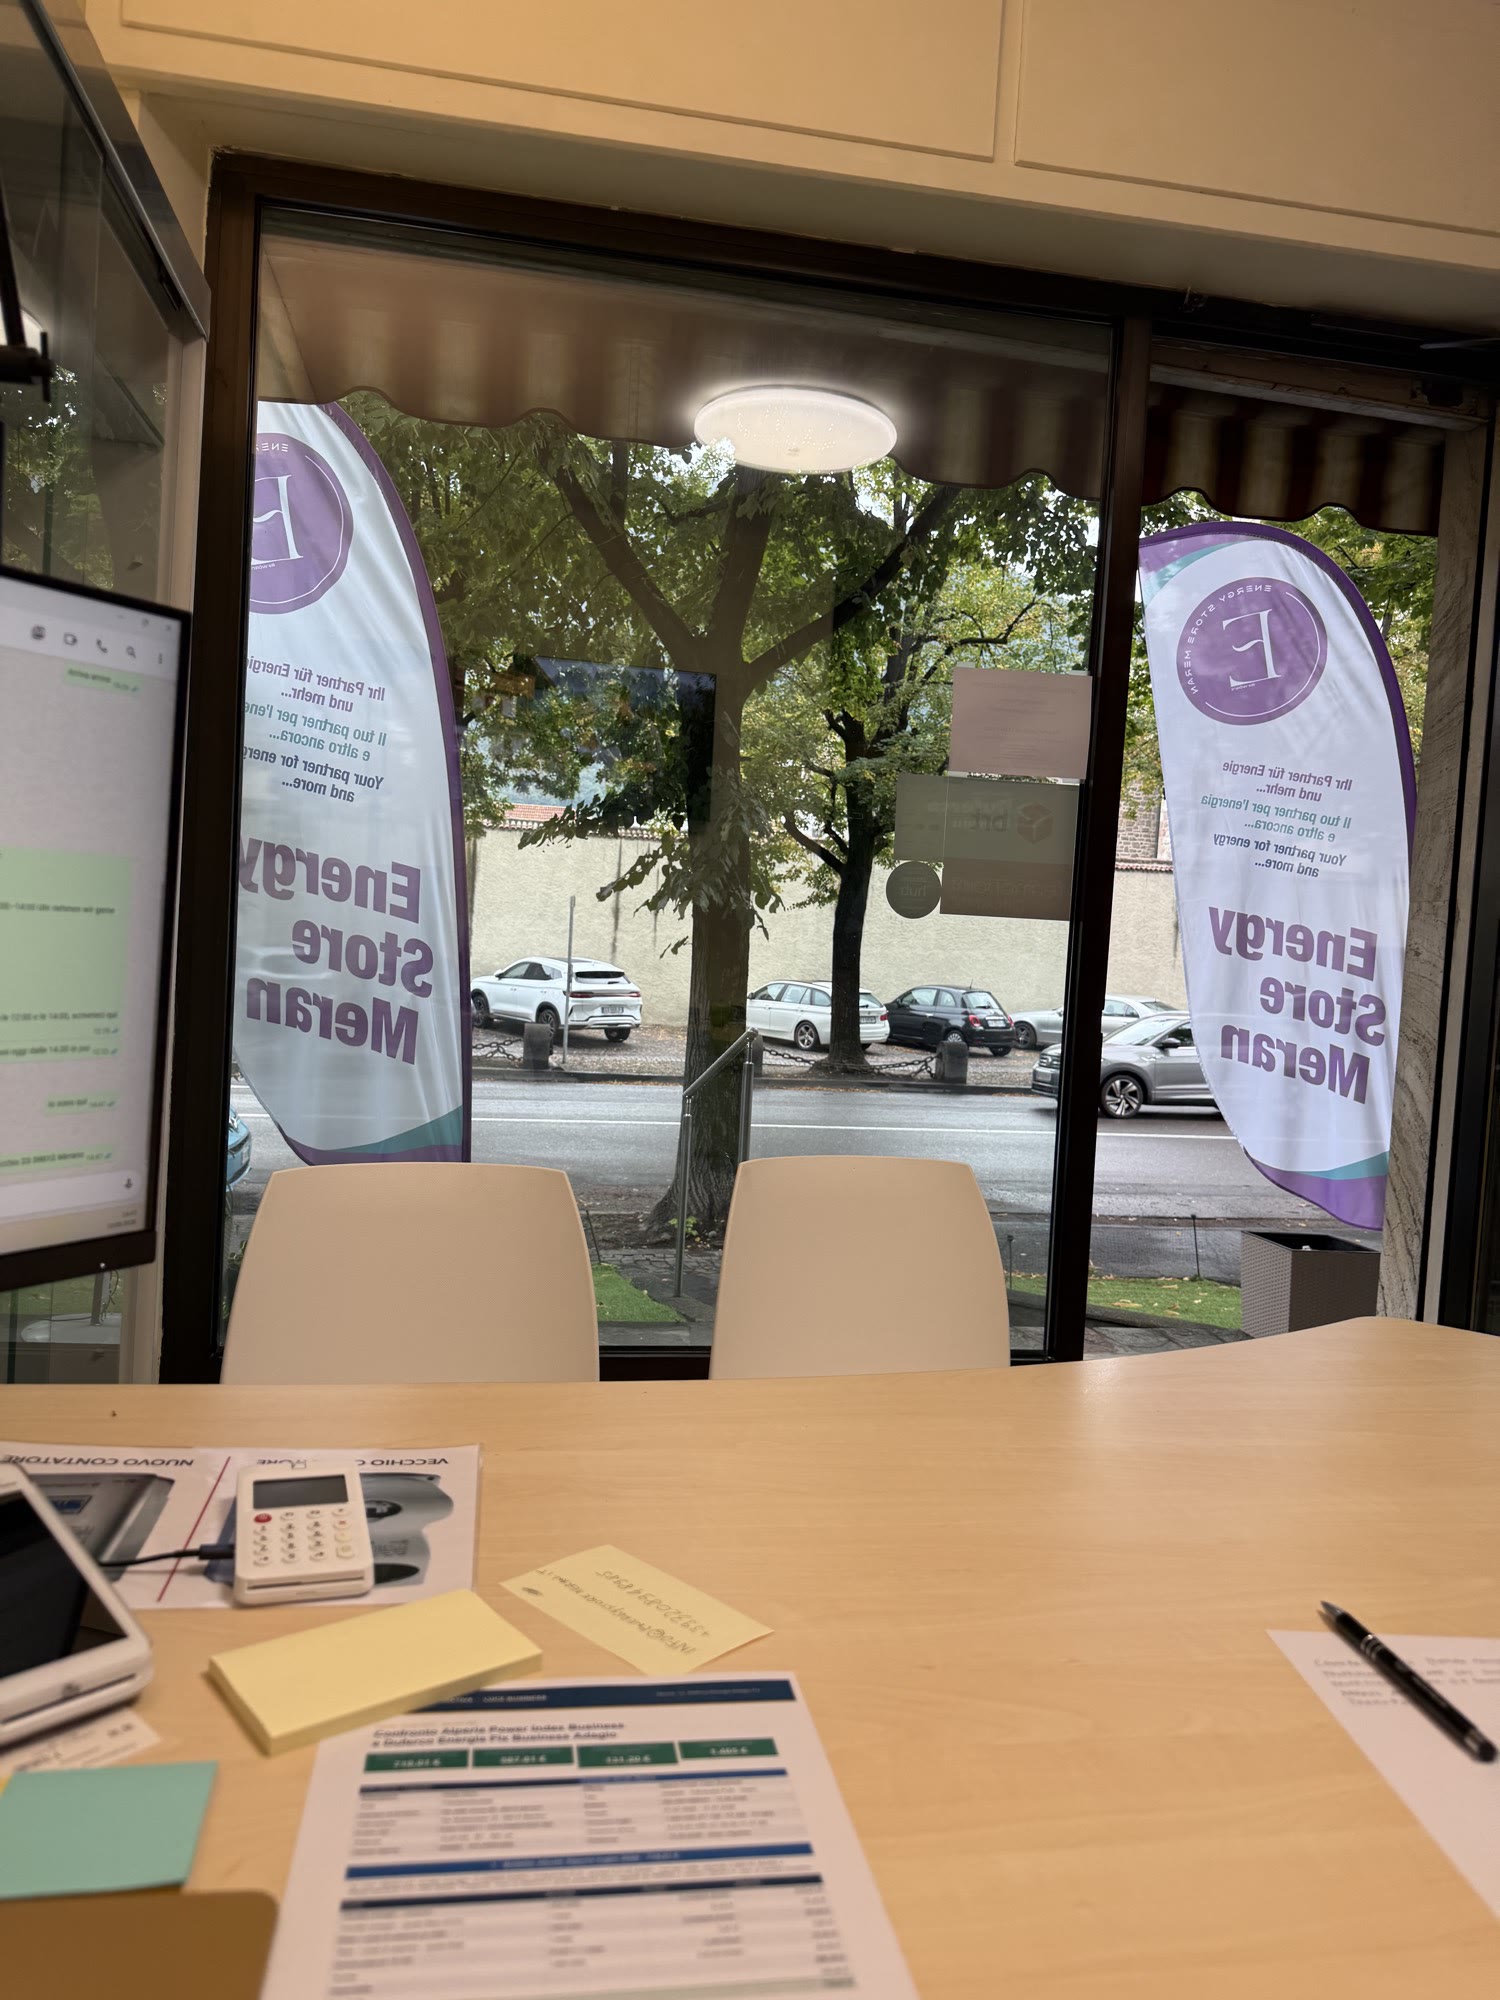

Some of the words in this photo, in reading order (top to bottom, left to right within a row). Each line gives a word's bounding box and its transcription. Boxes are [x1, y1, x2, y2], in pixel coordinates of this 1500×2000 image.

[3, 1456, 119, 1465] CONTATORE
[123, 1458, 194, 1466] NUOVO
[371, 1458, 448, 1466] VECCHIO
